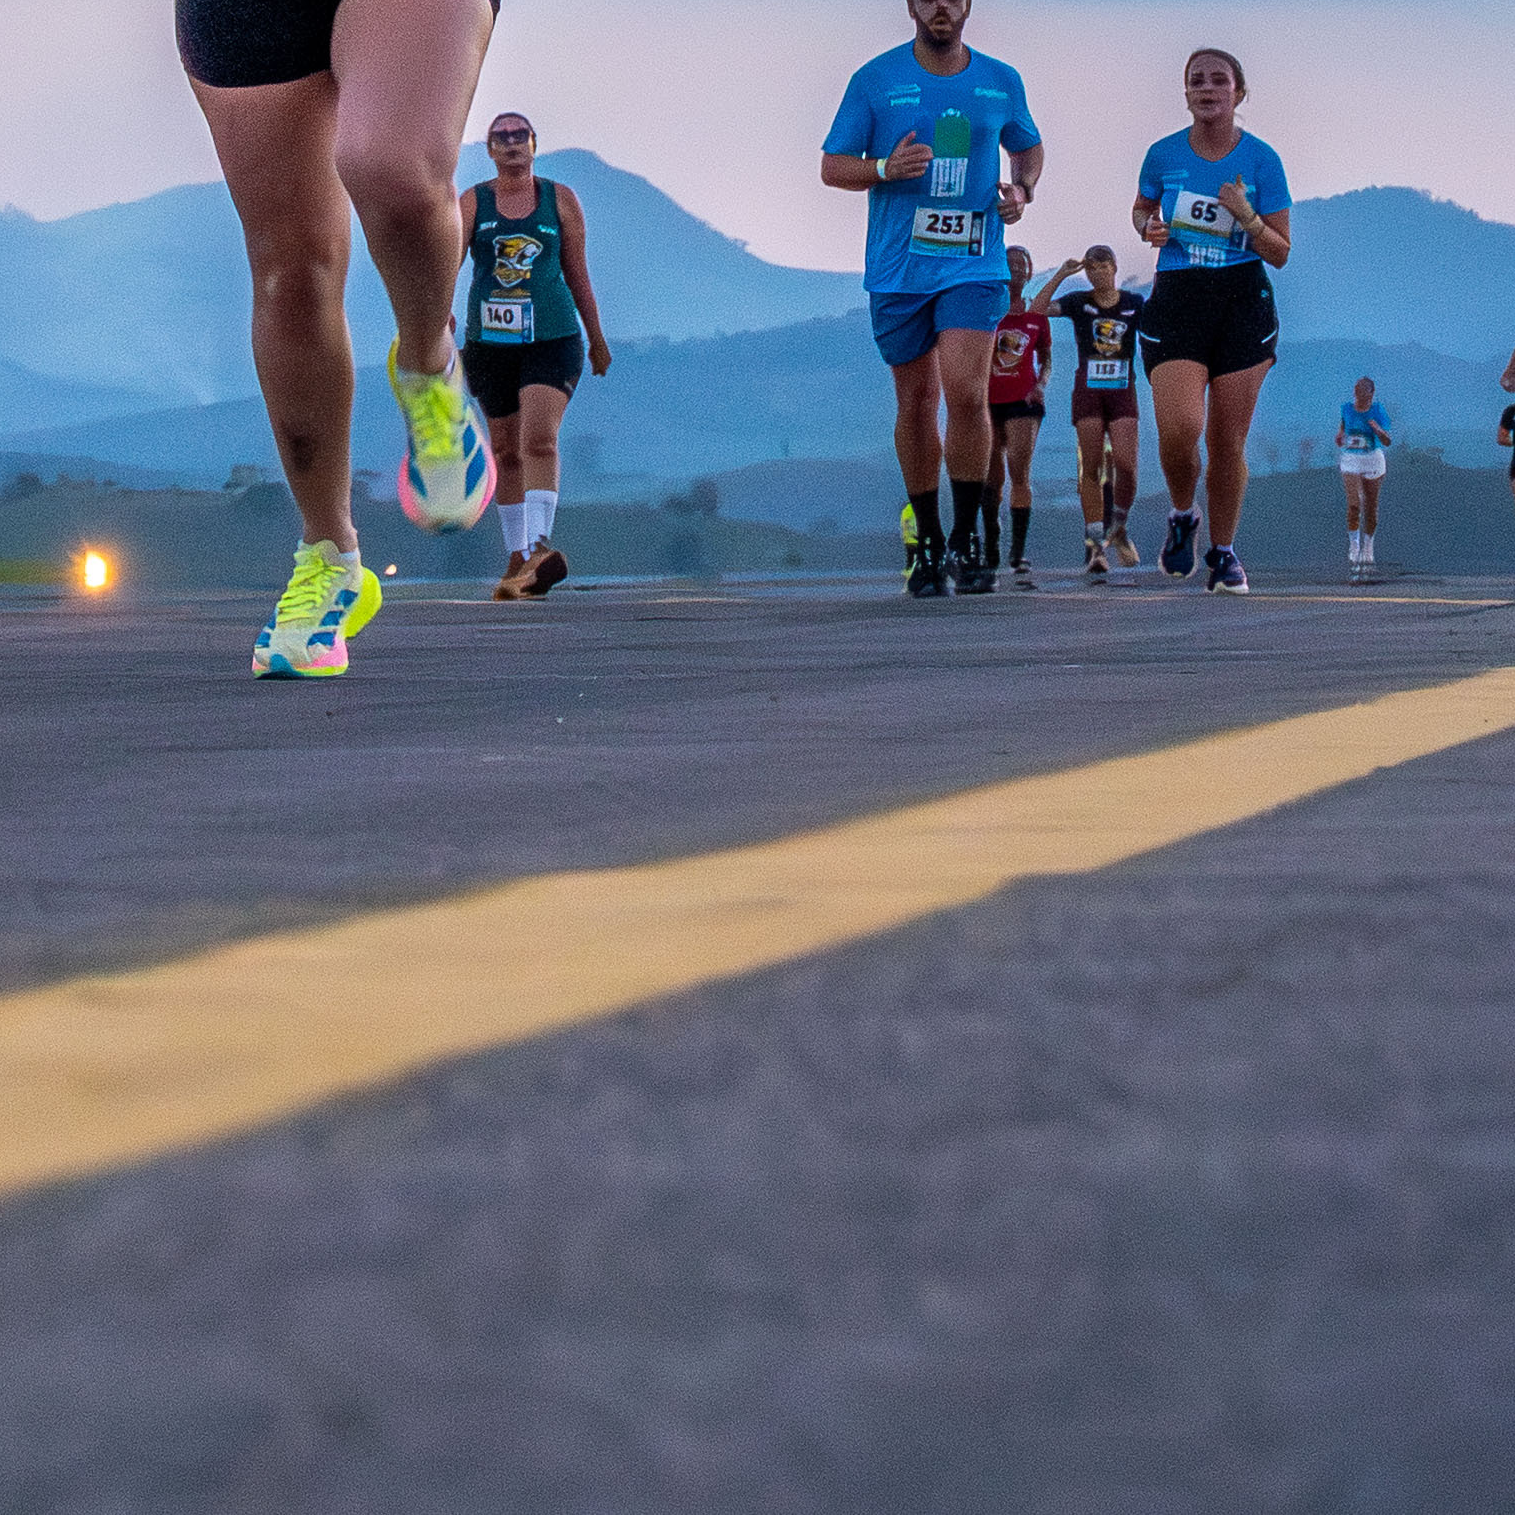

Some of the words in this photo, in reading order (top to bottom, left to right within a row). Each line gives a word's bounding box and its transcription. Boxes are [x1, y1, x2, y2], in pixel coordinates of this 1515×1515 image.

[1191, 200, 1218, 223] 65
[925, 213, 965, 235] 253
[487, 306, 514, 324] 140
